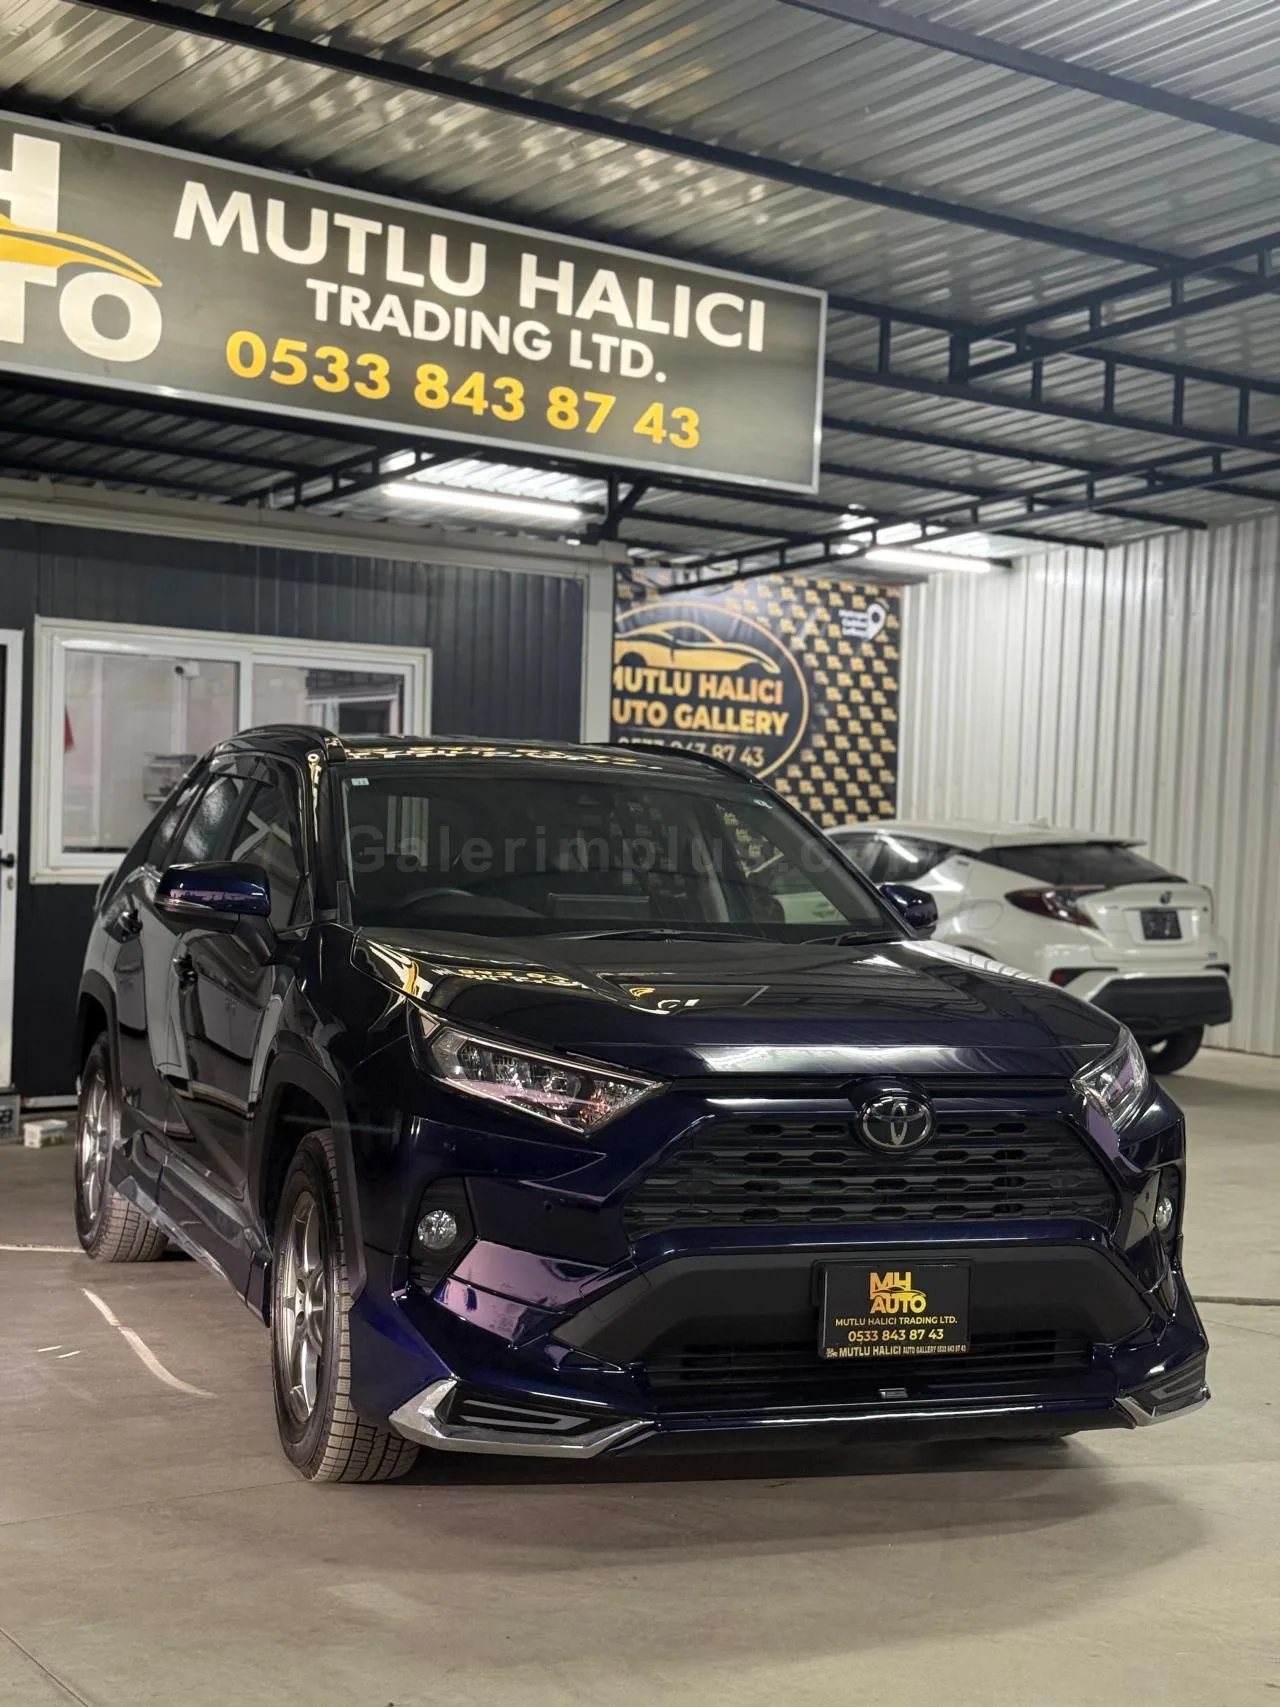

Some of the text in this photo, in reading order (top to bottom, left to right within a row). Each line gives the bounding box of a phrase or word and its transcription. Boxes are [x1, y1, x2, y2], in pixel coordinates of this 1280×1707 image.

[173, 180, 765, 352] MUTLU HALICI
[0, 259, 162, 362] TO
[306, 278, 667, 384] TRADING LTD.
[225, 330, 700, 449] 0533 843 87 43
[698, 673, 783, 705] HALICI
[612, 697, 789, 736] UTO GALLERY
[739, 745, 765, 768] 43
[869, 1271, 912, 1297] MH
[869, 1295, 927, 1314] AUTO
[835, 1315, 957, 1327] MUTLU HALICI TRADING LTD.
[848, 1329, 944, 1342] 0533 843 87 43
[839, 1347, 870, 1357] MUTLU
[872, 1346, 901, 1356] HALICI
